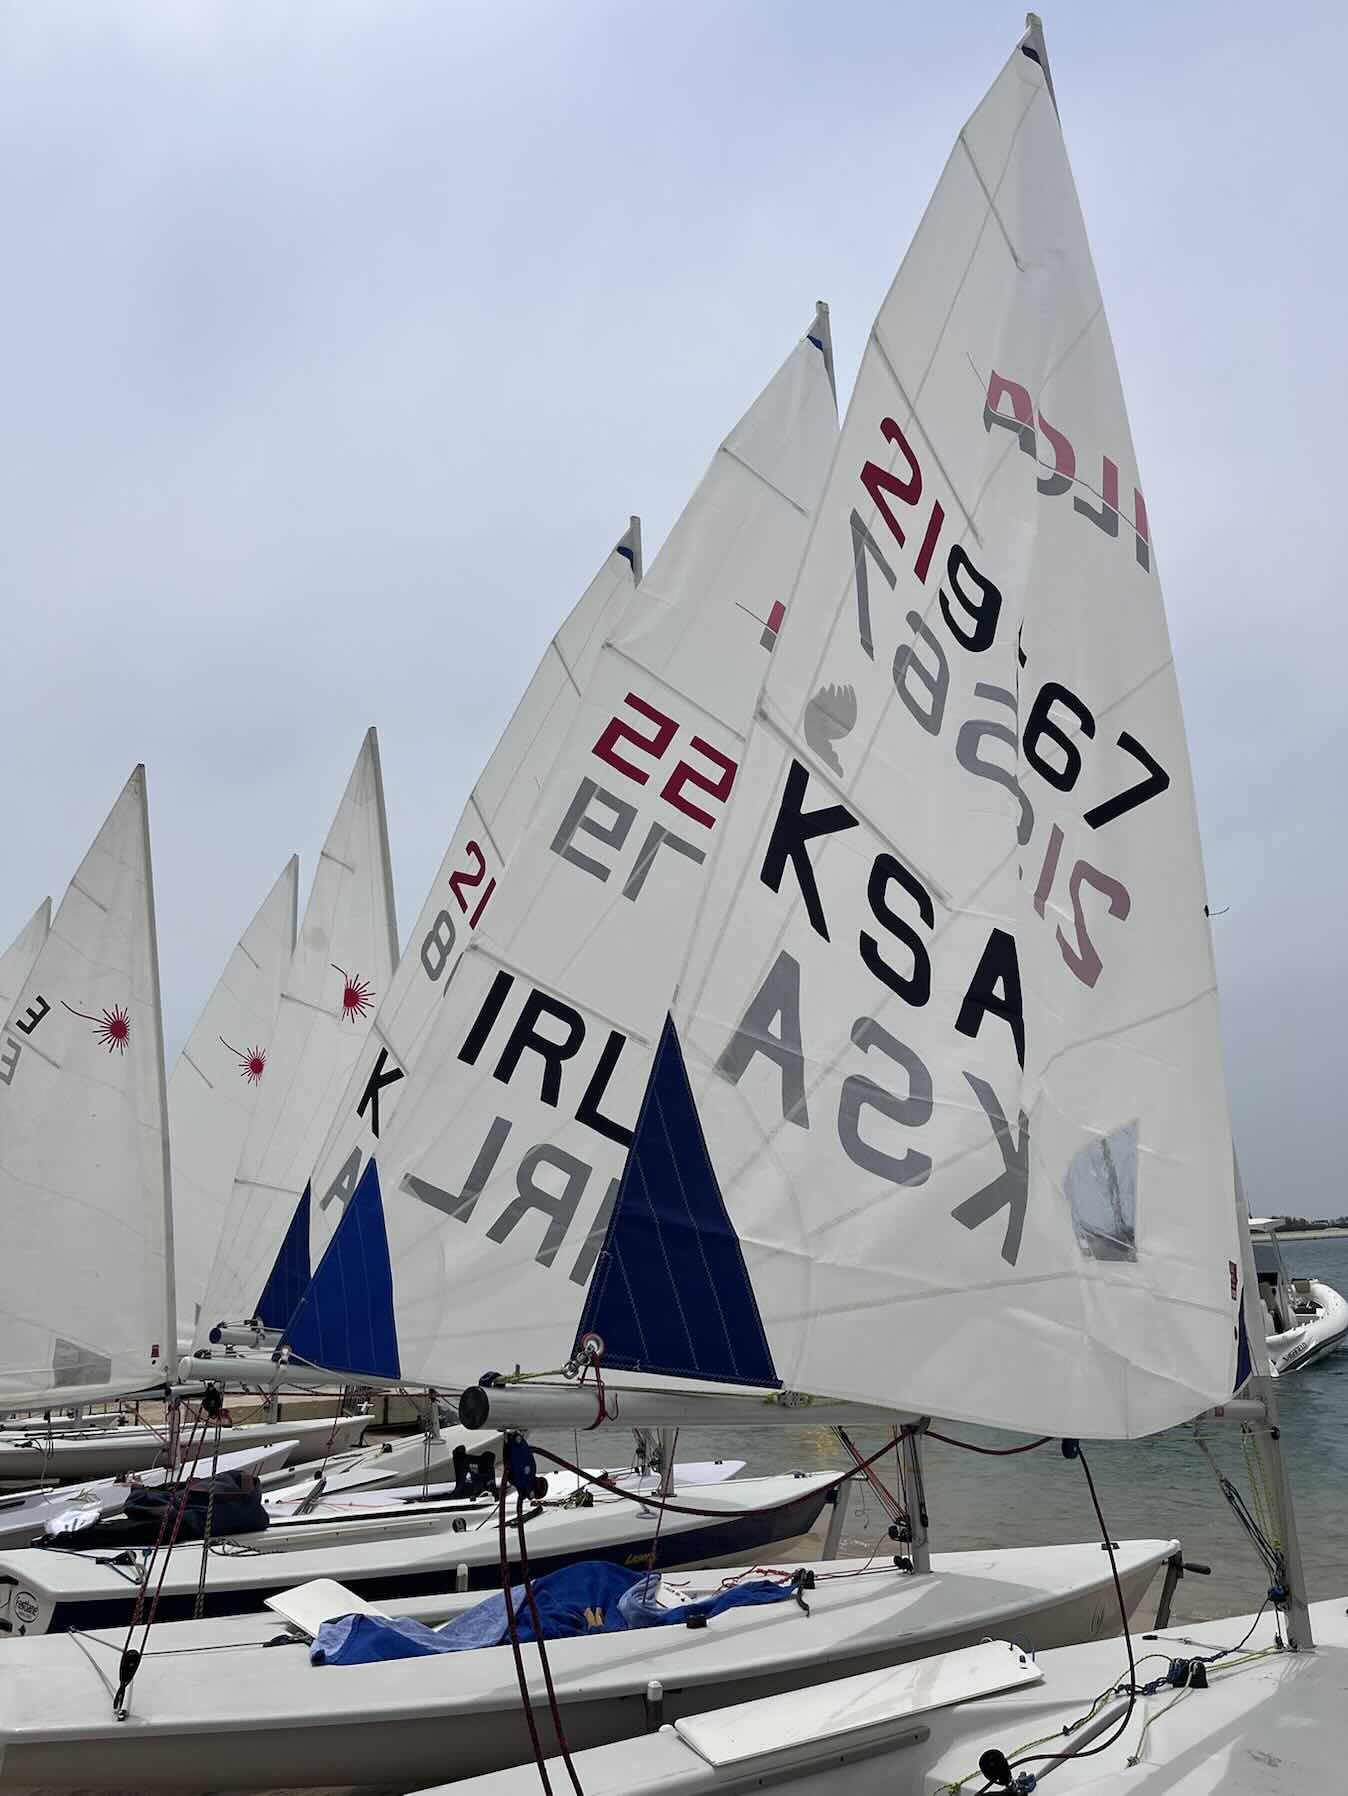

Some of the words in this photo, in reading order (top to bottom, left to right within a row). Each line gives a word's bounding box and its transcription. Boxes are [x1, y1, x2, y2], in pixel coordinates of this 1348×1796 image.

[860, 417, 1170, 830] 21967
[457, 970, 640, 1149] IRL
[760, 758, 1026, 1072] KSA
